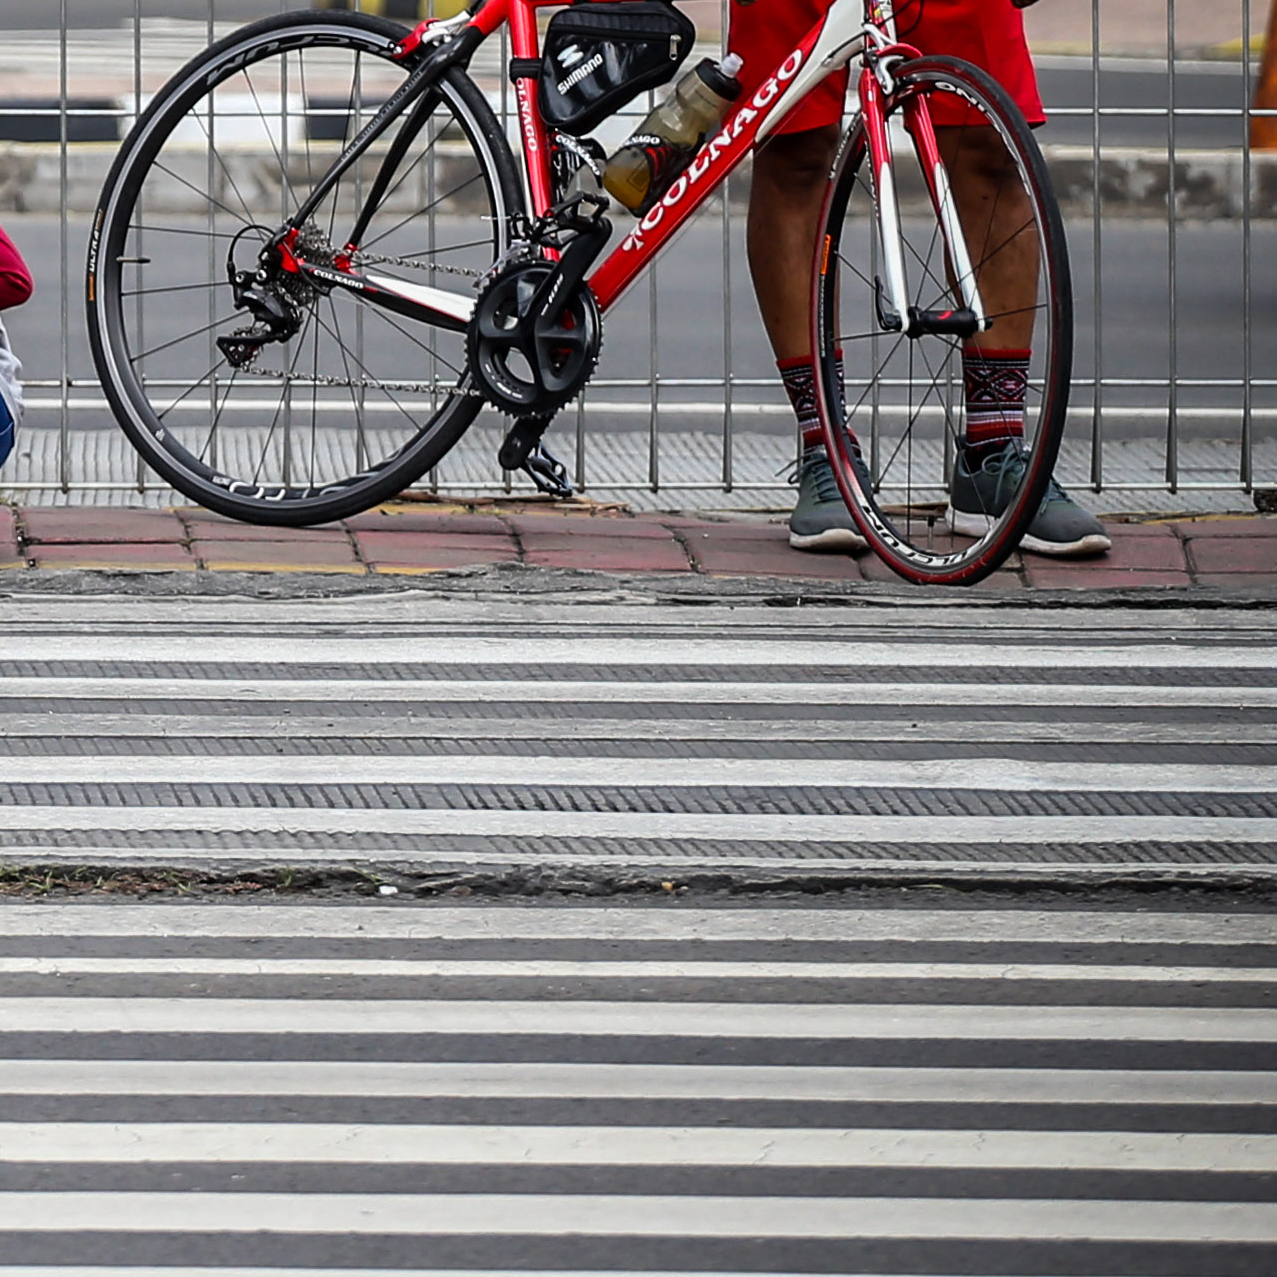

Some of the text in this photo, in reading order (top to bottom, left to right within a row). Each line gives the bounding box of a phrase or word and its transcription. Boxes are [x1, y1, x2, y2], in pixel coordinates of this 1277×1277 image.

[557, 53, 603, 95] SHIMANO
[516, 77, 538, 152] OLNAGO
[641, 49, 803, 230] COLNAGO
[313, 269, 364, 289] COLNAGO
